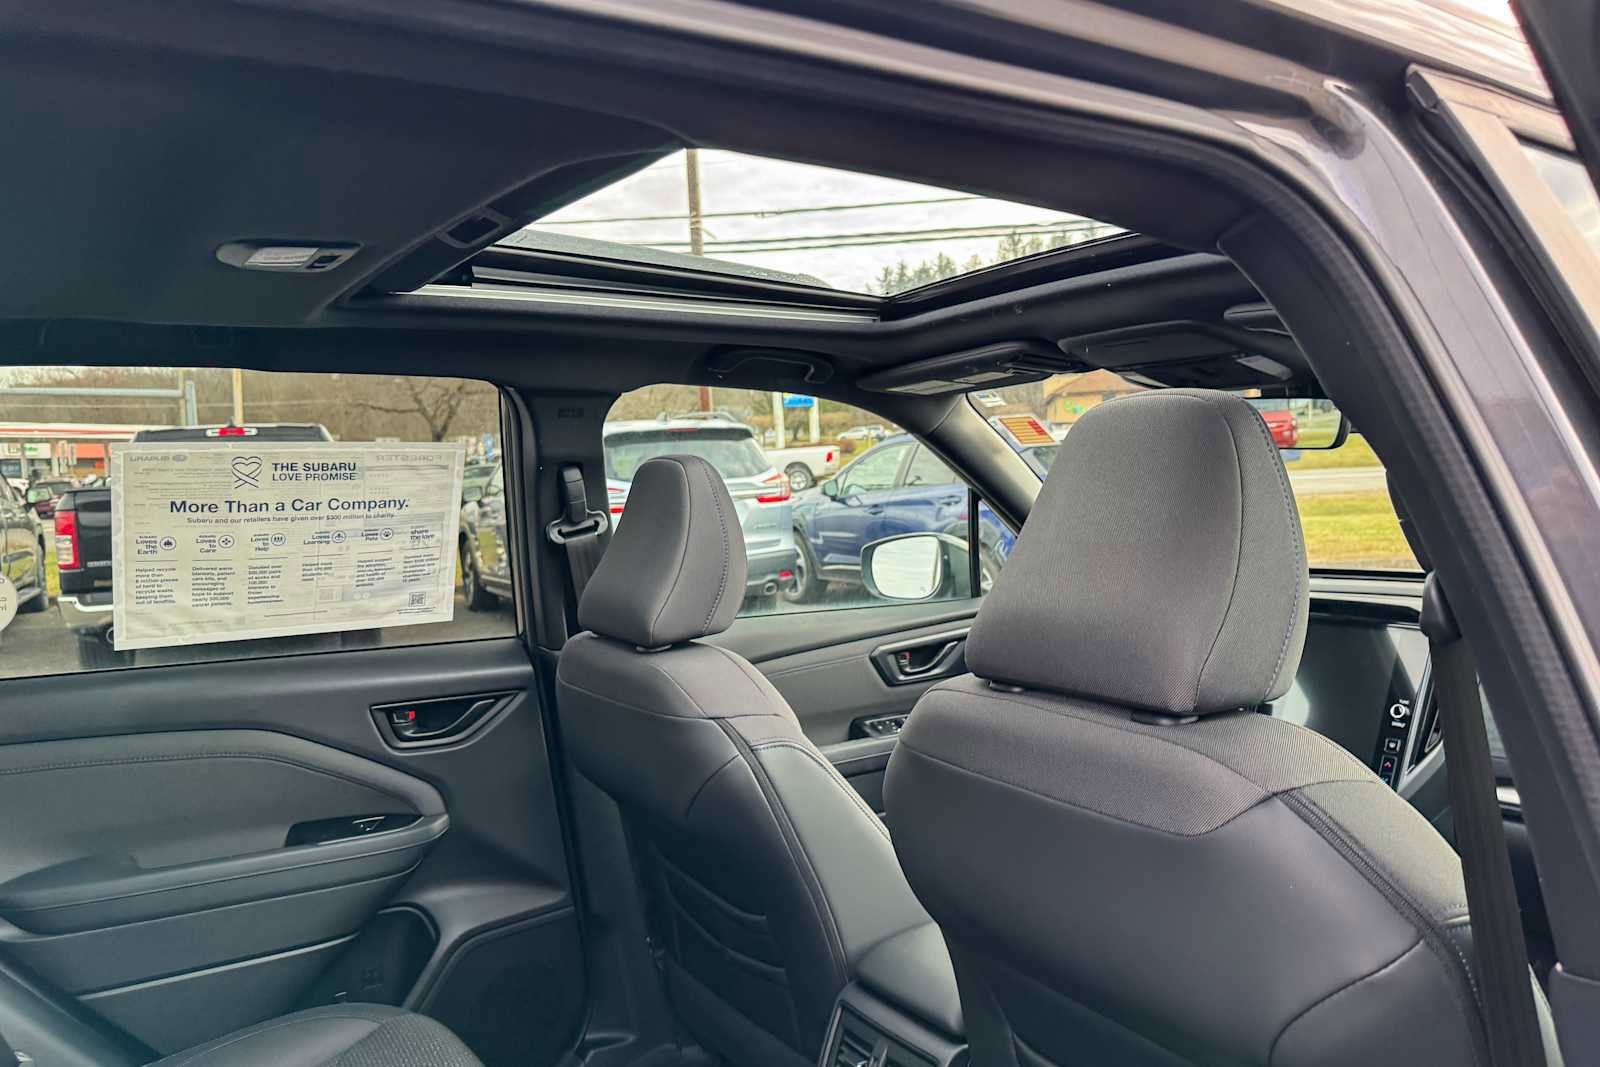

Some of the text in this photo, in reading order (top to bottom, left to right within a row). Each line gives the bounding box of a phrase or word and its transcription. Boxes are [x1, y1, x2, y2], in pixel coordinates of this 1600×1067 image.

[272, 462, 357, 472] THE SUBARU
[272, 472, 357, 482] LOVE PROMISE
[170, 498, 409, 514] More Than a Car Company.
[214, 517, 228, 525] and
[243, 516, 271, 524] retailers
[272, 515, 288, 523] have
[290, 515, 309, 523] given
